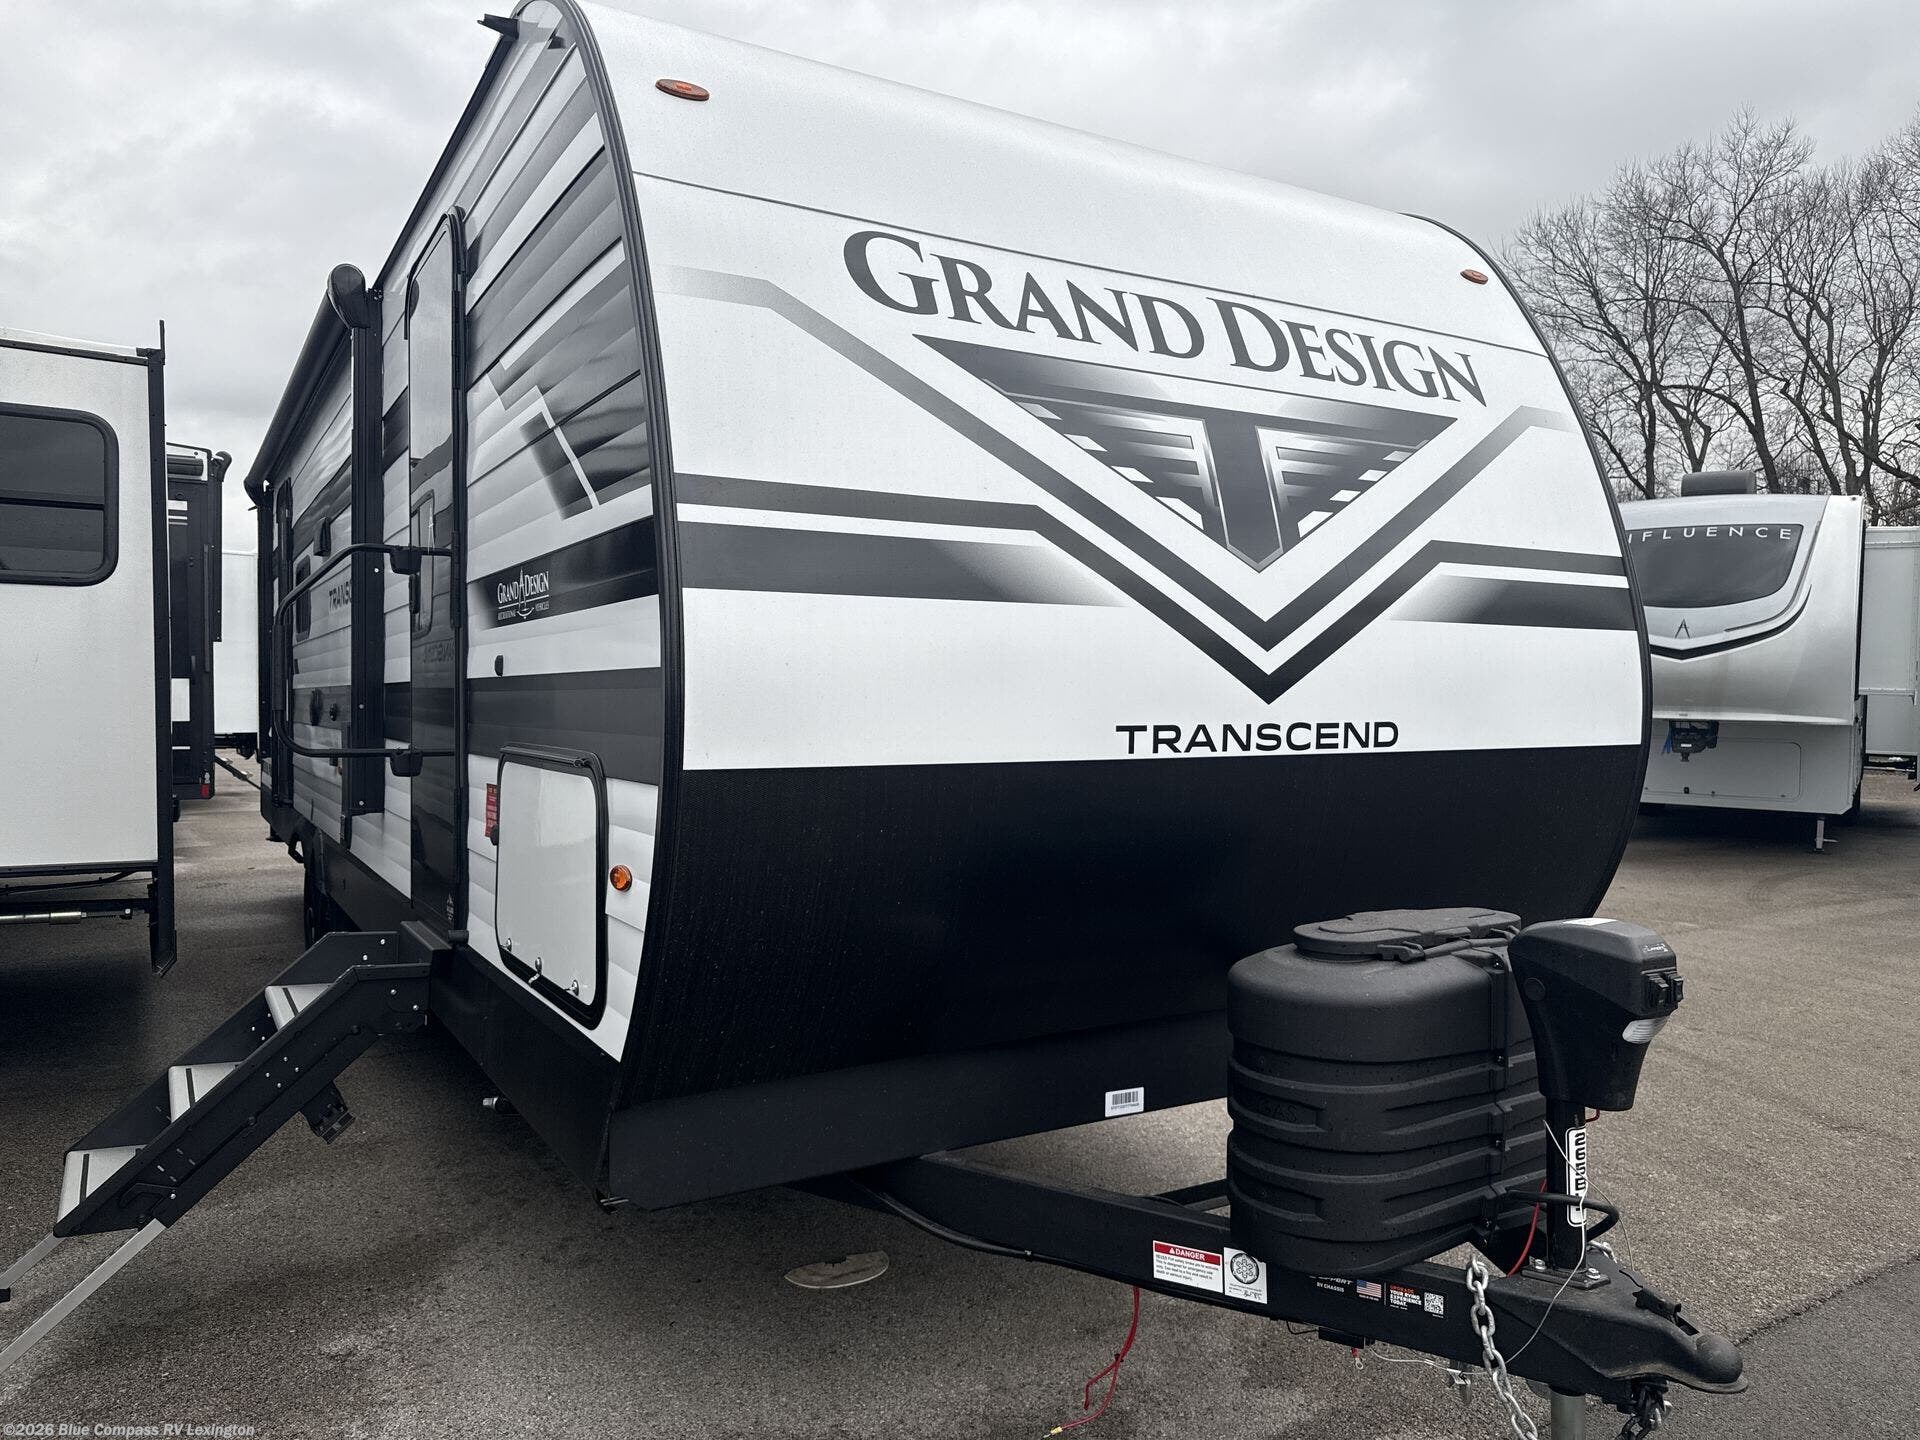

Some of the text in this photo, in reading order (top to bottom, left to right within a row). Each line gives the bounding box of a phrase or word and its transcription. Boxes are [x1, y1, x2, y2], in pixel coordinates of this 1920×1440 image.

[843, 230, 1487, 407] GRAND DESIGN
[1116, 722, 1399, 755] TRANSCEND
[1175, 1248, 1206, 1261] DANGER
[1323, 1283, 1345, 1293] CHASSIS
[1390, 1294, 1422, 1305] EXPERIENCE
